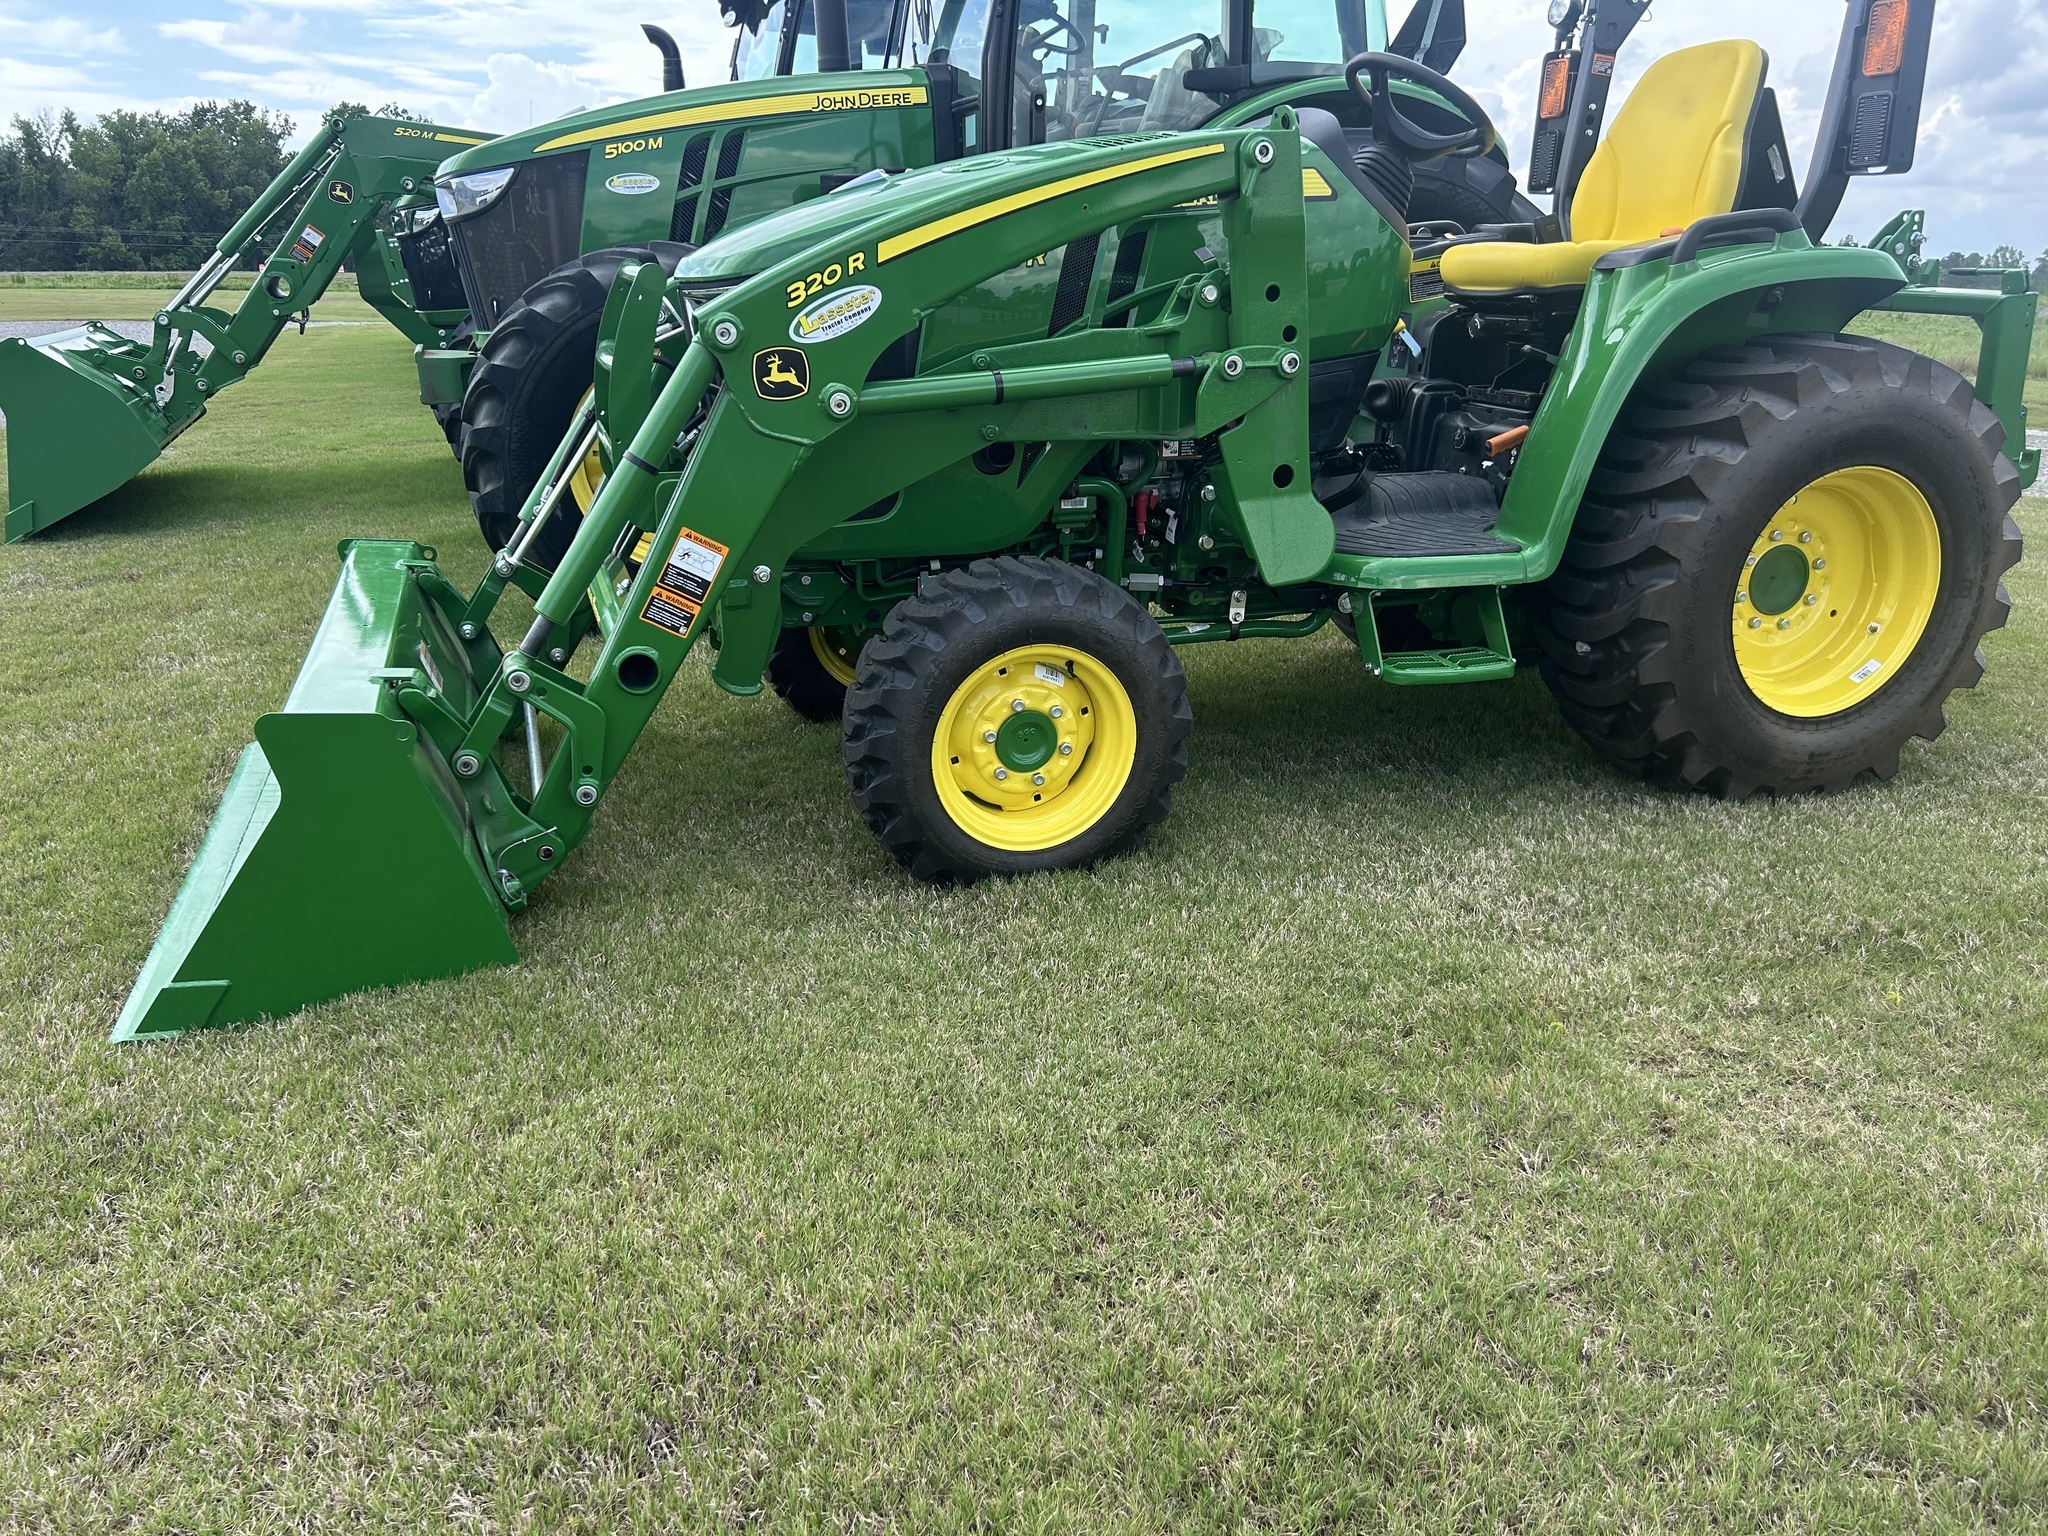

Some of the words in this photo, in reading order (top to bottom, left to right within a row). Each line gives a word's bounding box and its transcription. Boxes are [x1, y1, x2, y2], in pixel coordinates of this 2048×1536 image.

[812, 95, 856, 111] JOHN
[858, 92, 913, 106] DEERE
[393, 126, 421, 138] 520
[421, 131, 434, 140] M
[604, 140, 646, 159] 5100
[648, 136, 663, 150] M
[785, 263, 843, 309] 320
[847, 251, 866, 277] R
[798, 289, 876, 336] Lasseter
[821, 317, 844, 333] Tractor
[843, 305, 872, 323] Company
[693, 535, 722, 553] WARNING
[665, 595, 694, 611] WARNING
